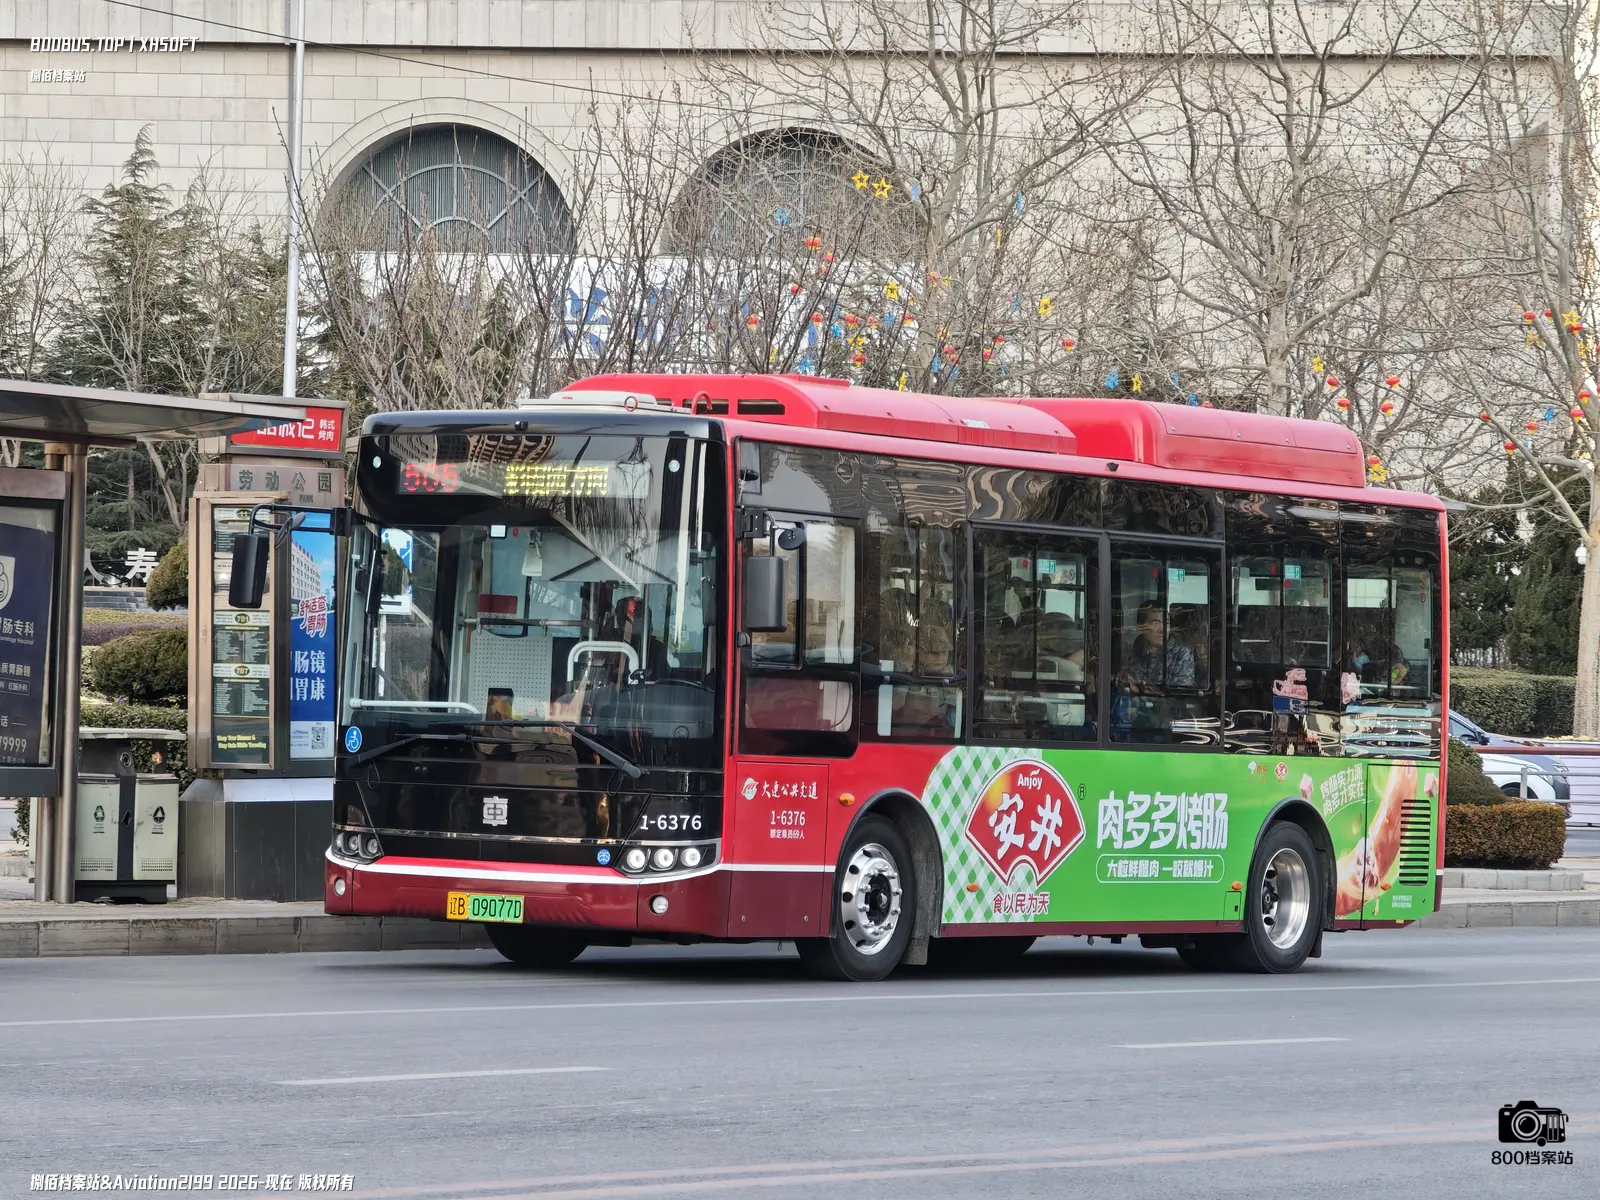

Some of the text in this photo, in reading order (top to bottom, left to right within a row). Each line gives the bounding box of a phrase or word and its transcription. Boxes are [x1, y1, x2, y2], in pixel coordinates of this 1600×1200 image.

[319, 419, 335, 430] 韩式
[318, 430, 334, 442] 烤肉
[239, 469, 332, 493] 劳动公园
[403, 463, 458, 492] 505
[0, 617, 34, 637] 肠专科
[306, 613, 327, 638] 胃肠
[290, 650, 326, 674] 肠镜
[290, 677, 326, 701] 胃康
[762, 780, 818, 799] 大连公共交通
[1017, 769, 1043, 790] Anjoy
[640, 814, 702, 831] 1-6376
[770, 810, 806, 826] 1-6376
[989, 793, 1063, 860] 安井
[1096, 790, 1229, 849] 肉多多烤肠
[1162, 860, 1214, 878] 一咬就爆汁
[472, 898, 522, 919] 09077D
[992, 893, 1051, 915] 食以民为天
